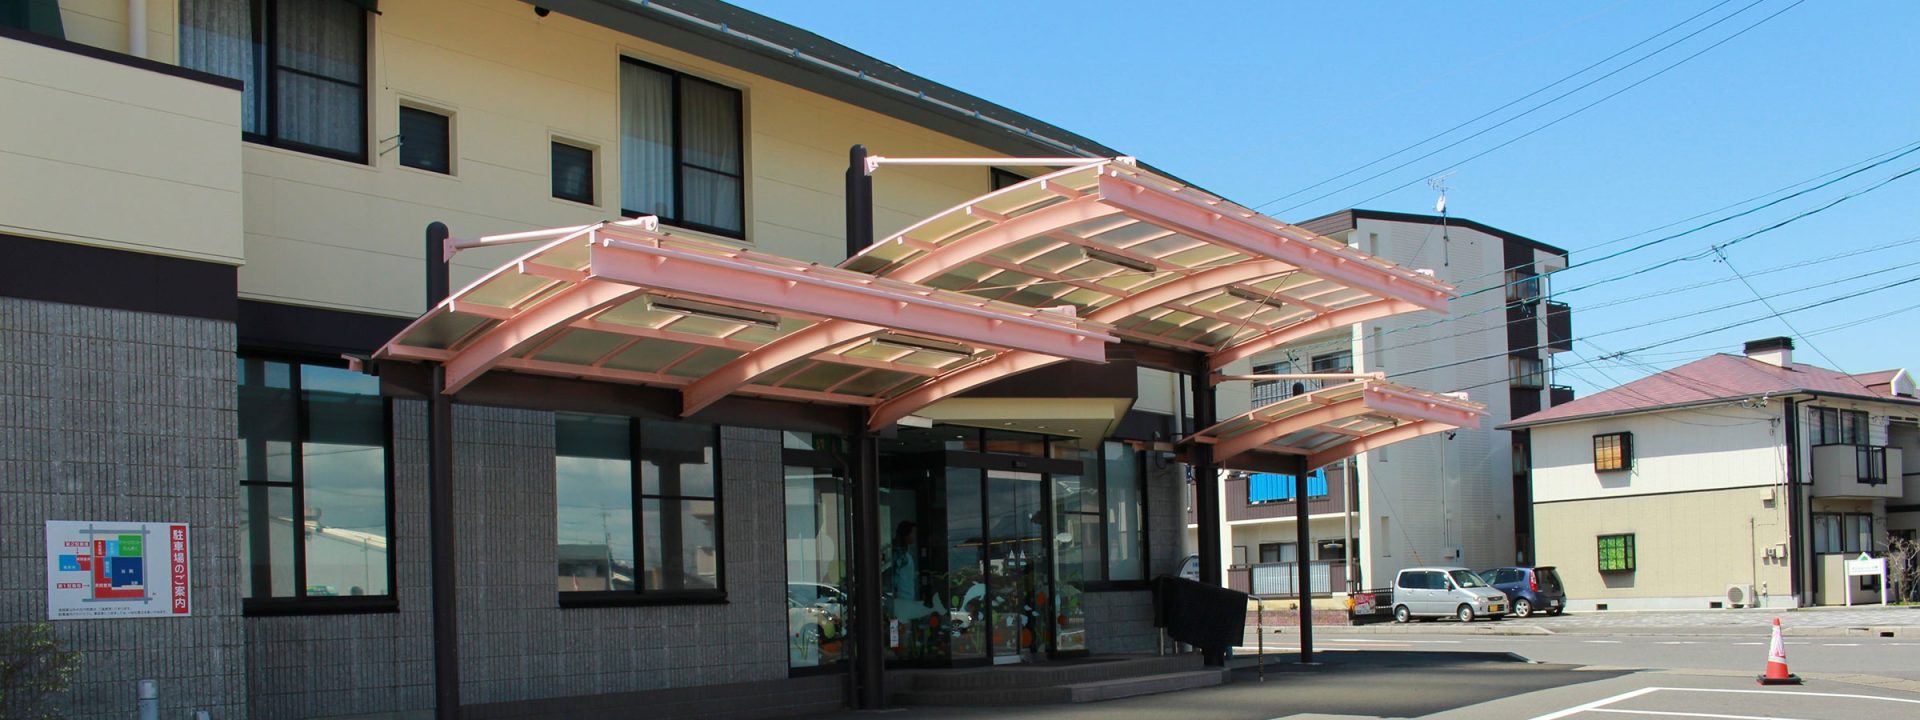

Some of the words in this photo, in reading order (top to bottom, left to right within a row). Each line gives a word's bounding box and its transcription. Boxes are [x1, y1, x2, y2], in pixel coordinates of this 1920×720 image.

[172, 529, 186, 609] 駐車場のご案内
